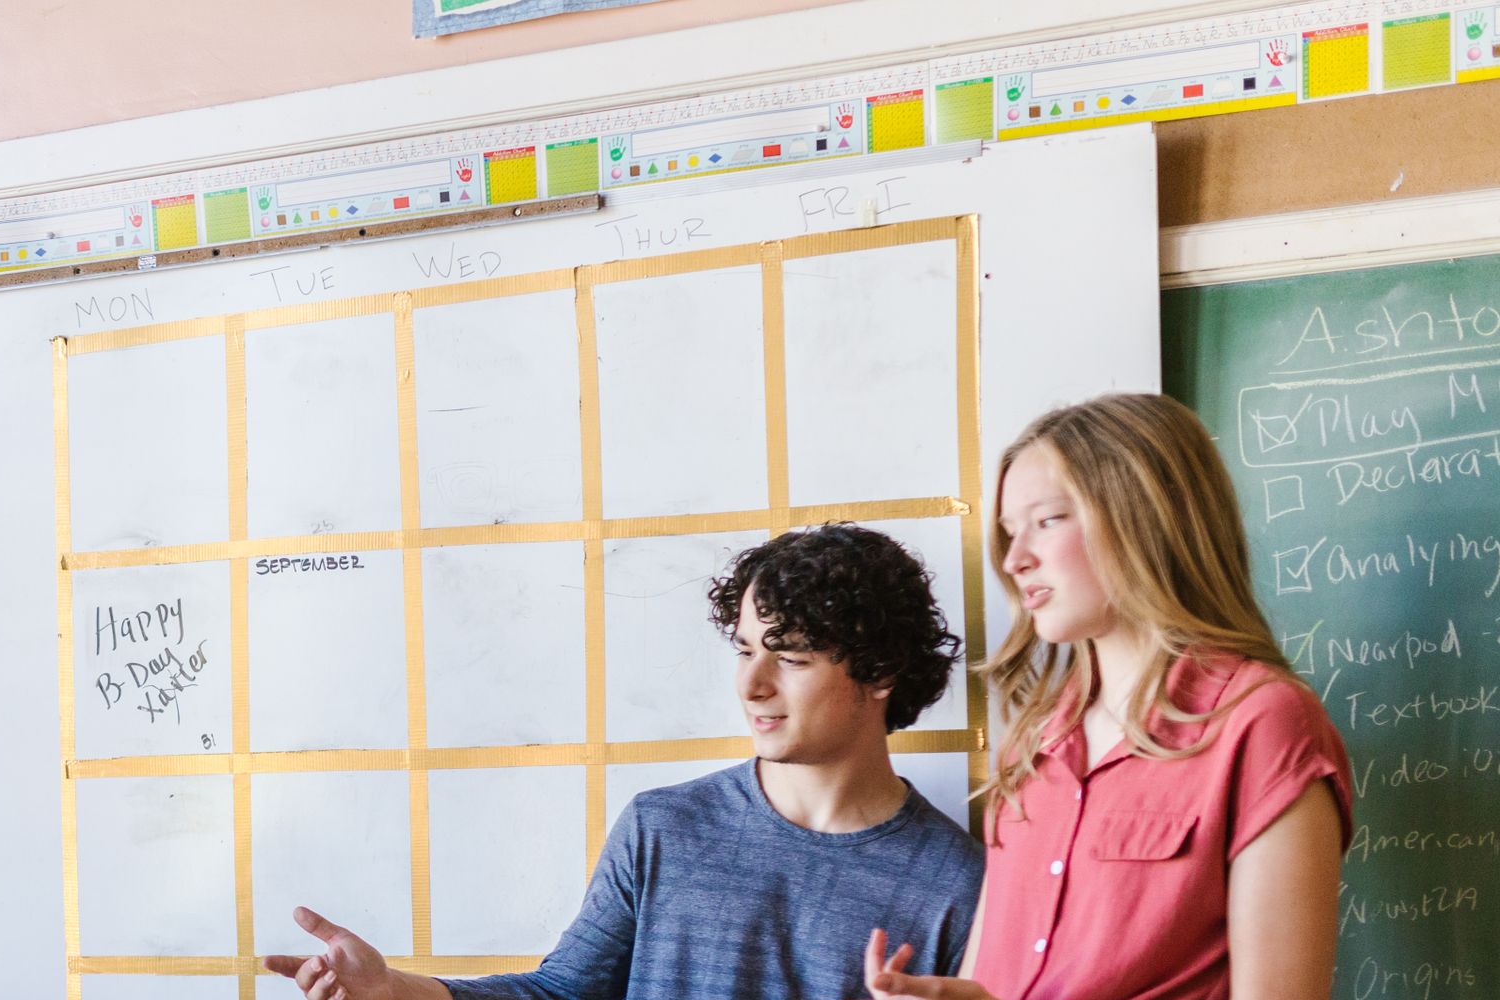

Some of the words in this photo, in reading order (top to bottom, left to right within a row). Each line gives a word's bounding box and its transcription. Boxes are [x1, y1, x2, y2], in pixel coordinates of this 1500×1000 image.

[74, 287, 155, 329] MON
[250, 264, 337, 302] TUE
[411, 241, 502, 280] WED
[595, 214, 712, 257] THUR
[799, 176, 911, 232] FRI
[1308, 394, 1422, 455] Play
[255, 555, 365, 576] SEPTEMBER
[95, 598, 186, 657] Happy
[1328, 619, 1462, 670] Nearpod
[1346, 686, 1500, 730] Textbook
[1350, 753, 1449, 798] Video
